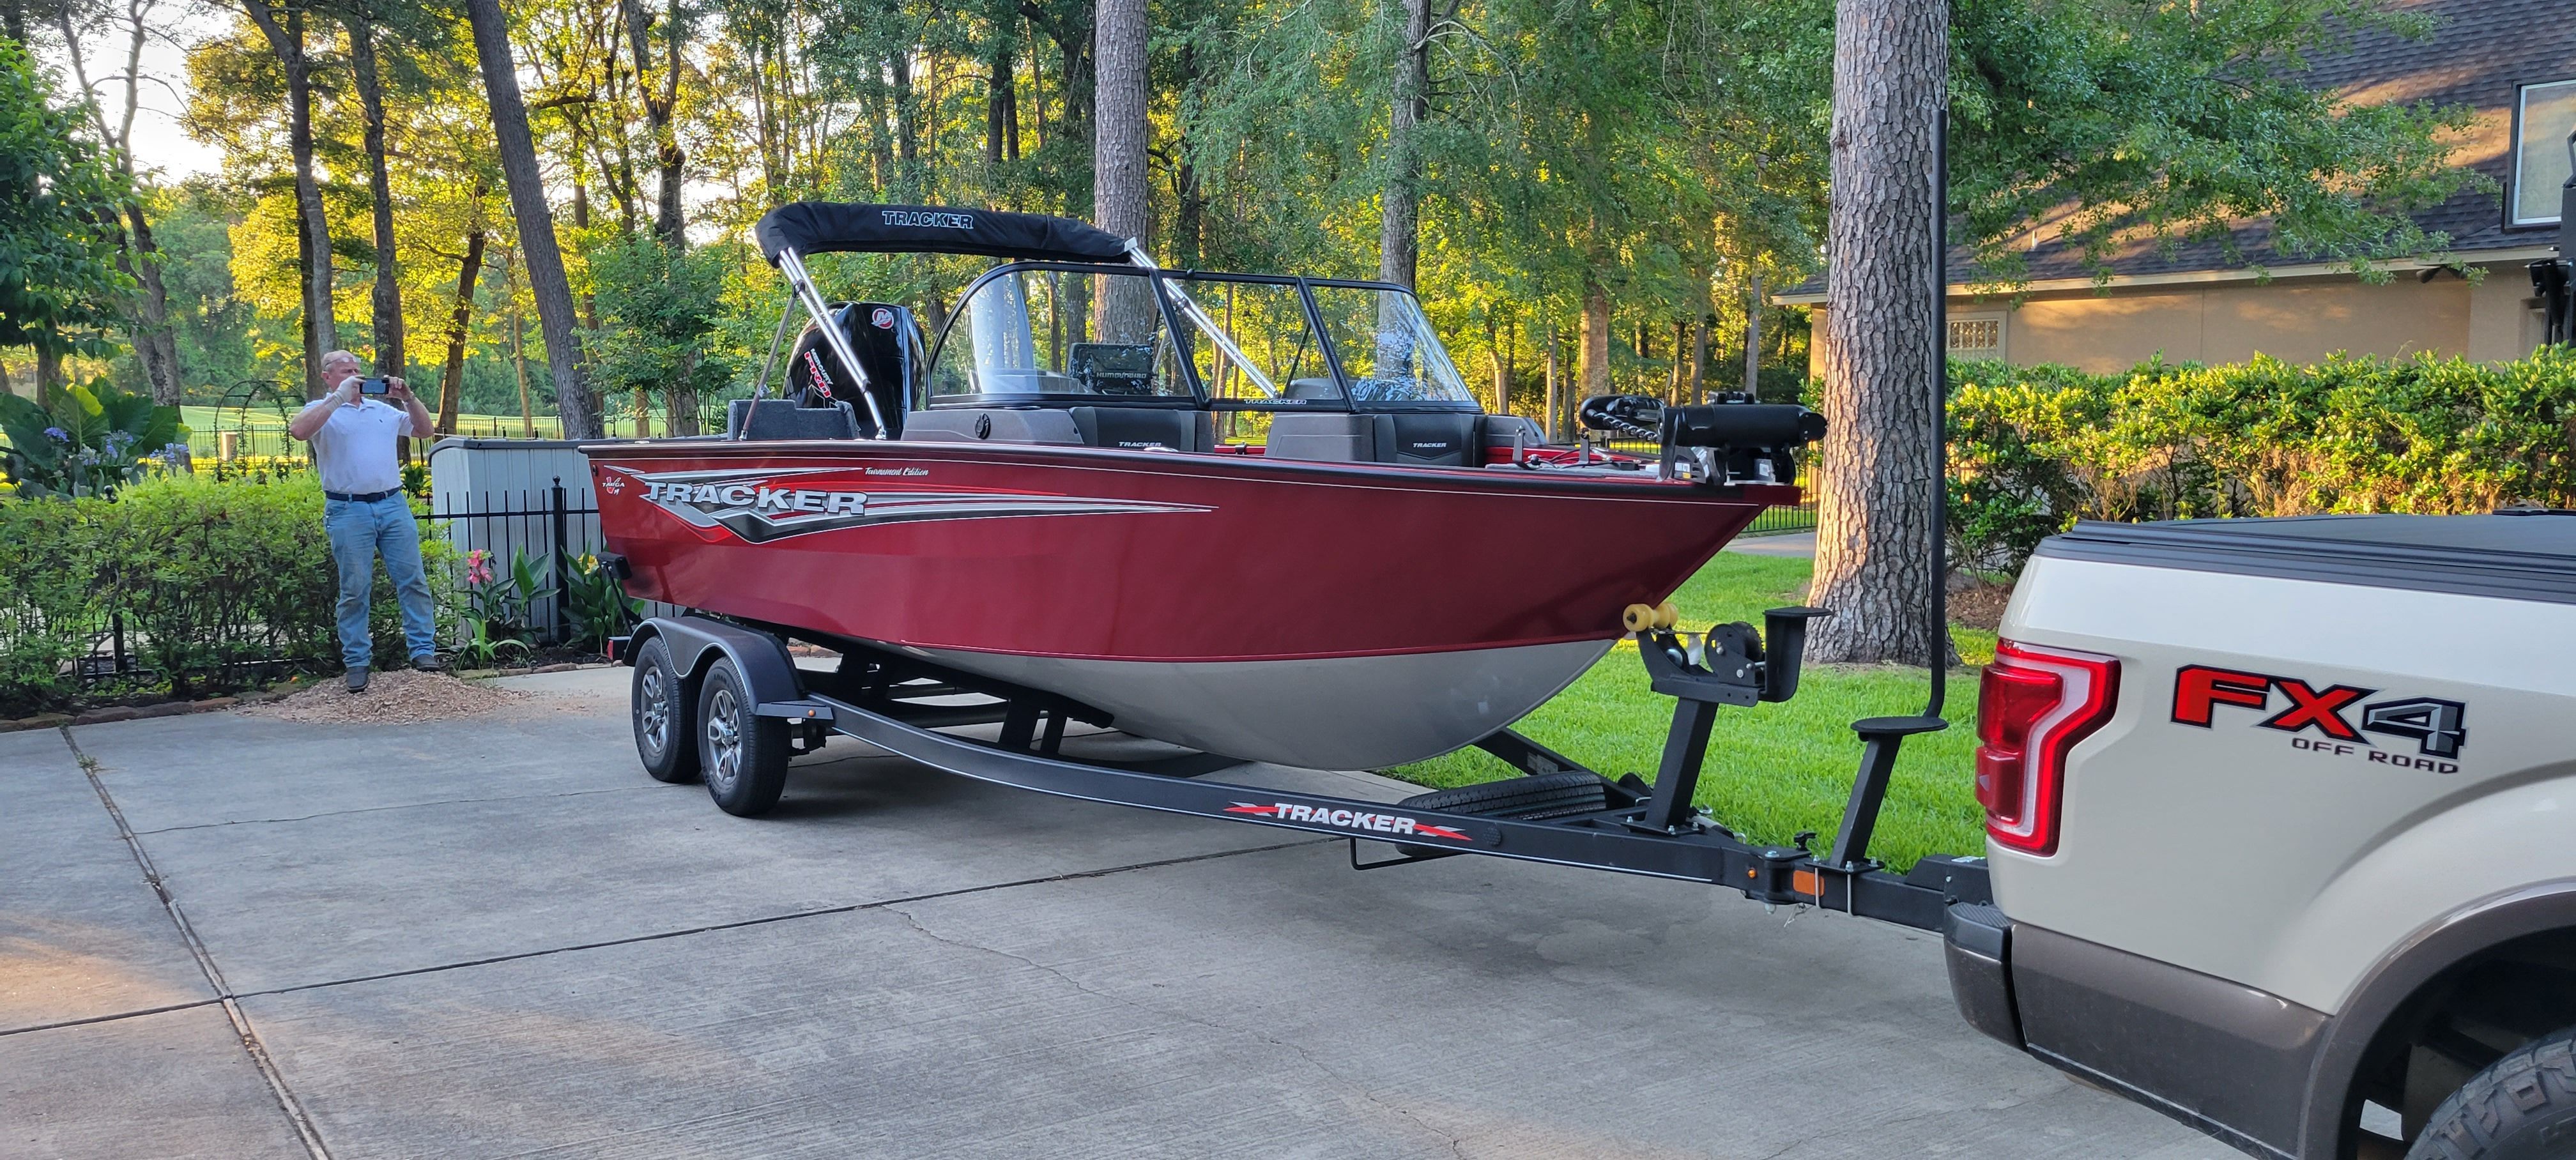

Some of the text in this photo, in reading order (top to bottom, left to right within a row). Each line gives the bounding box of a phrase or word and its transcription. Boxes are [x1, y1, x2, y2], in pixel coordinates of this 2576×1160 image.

[882, 211, 974, 229] TRACKER
[810, 348, 834, 385] MERCURY
[864, 467, 929, 476] Tournament Edition
[645, 482, 868, 516] TRACKER
[2171, 664, 2468, 760] FX4
[2291, 738, 2459, 774] OFF ROAD
[1274, 802, 1416, 835] TRACKER
